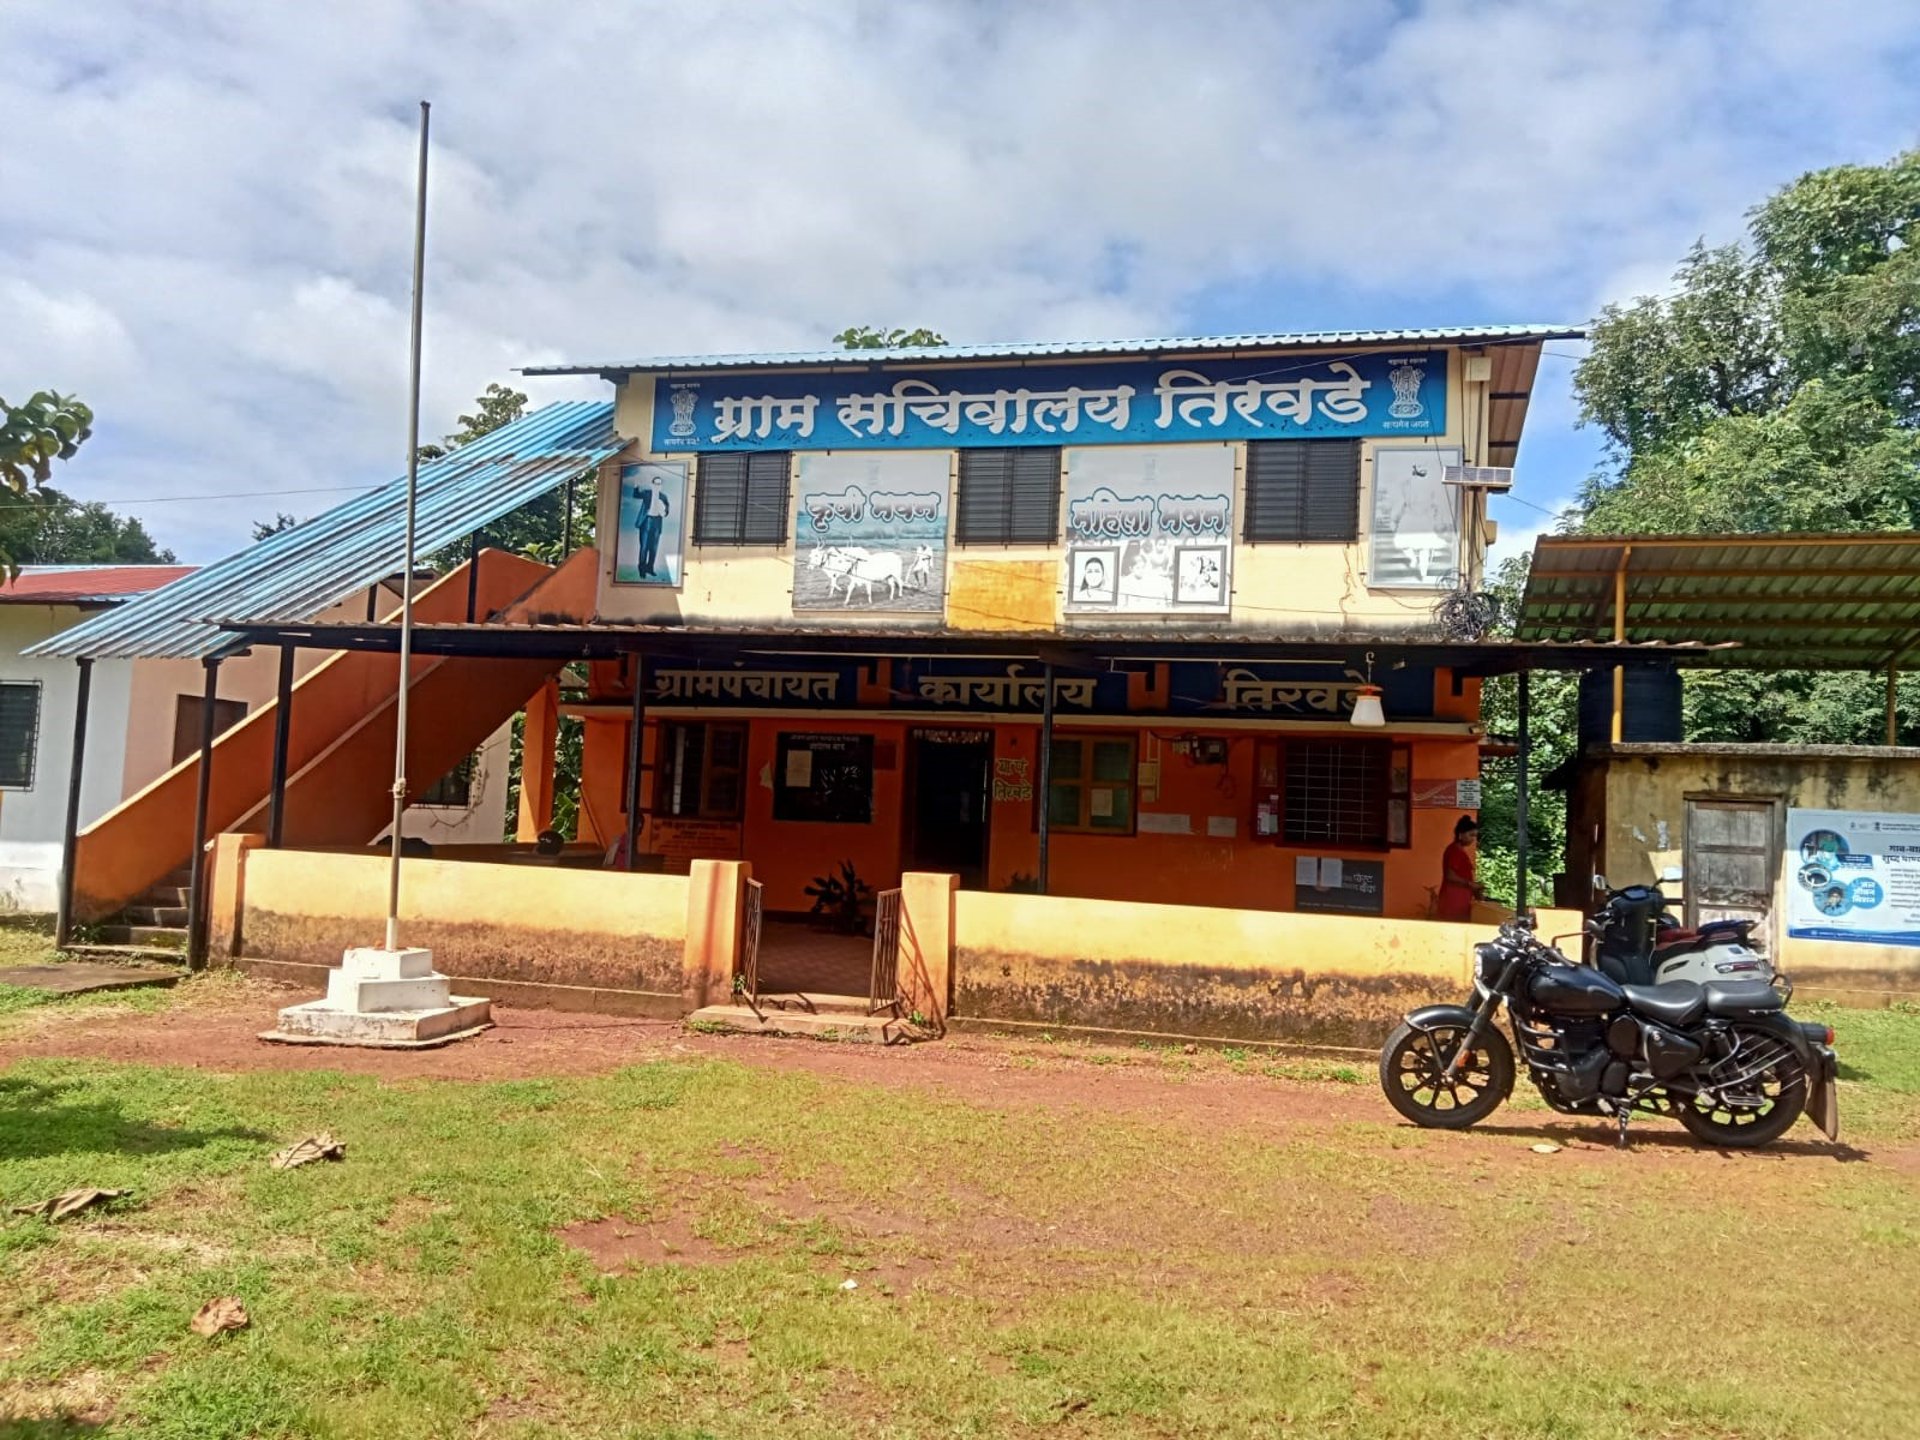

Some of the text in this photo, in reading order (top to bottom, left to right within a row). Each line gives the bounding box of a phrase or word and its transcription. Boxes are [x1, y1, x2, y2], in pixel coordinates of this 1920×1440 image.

[712, 362, 1372, 443] ग्राम सचिवालय तिरवडे
[869, 490, 942, 523] भवन
[1070, 486, 1230, 539] महिला भवन
[918, 664, 1097, 709] कार्यालय
